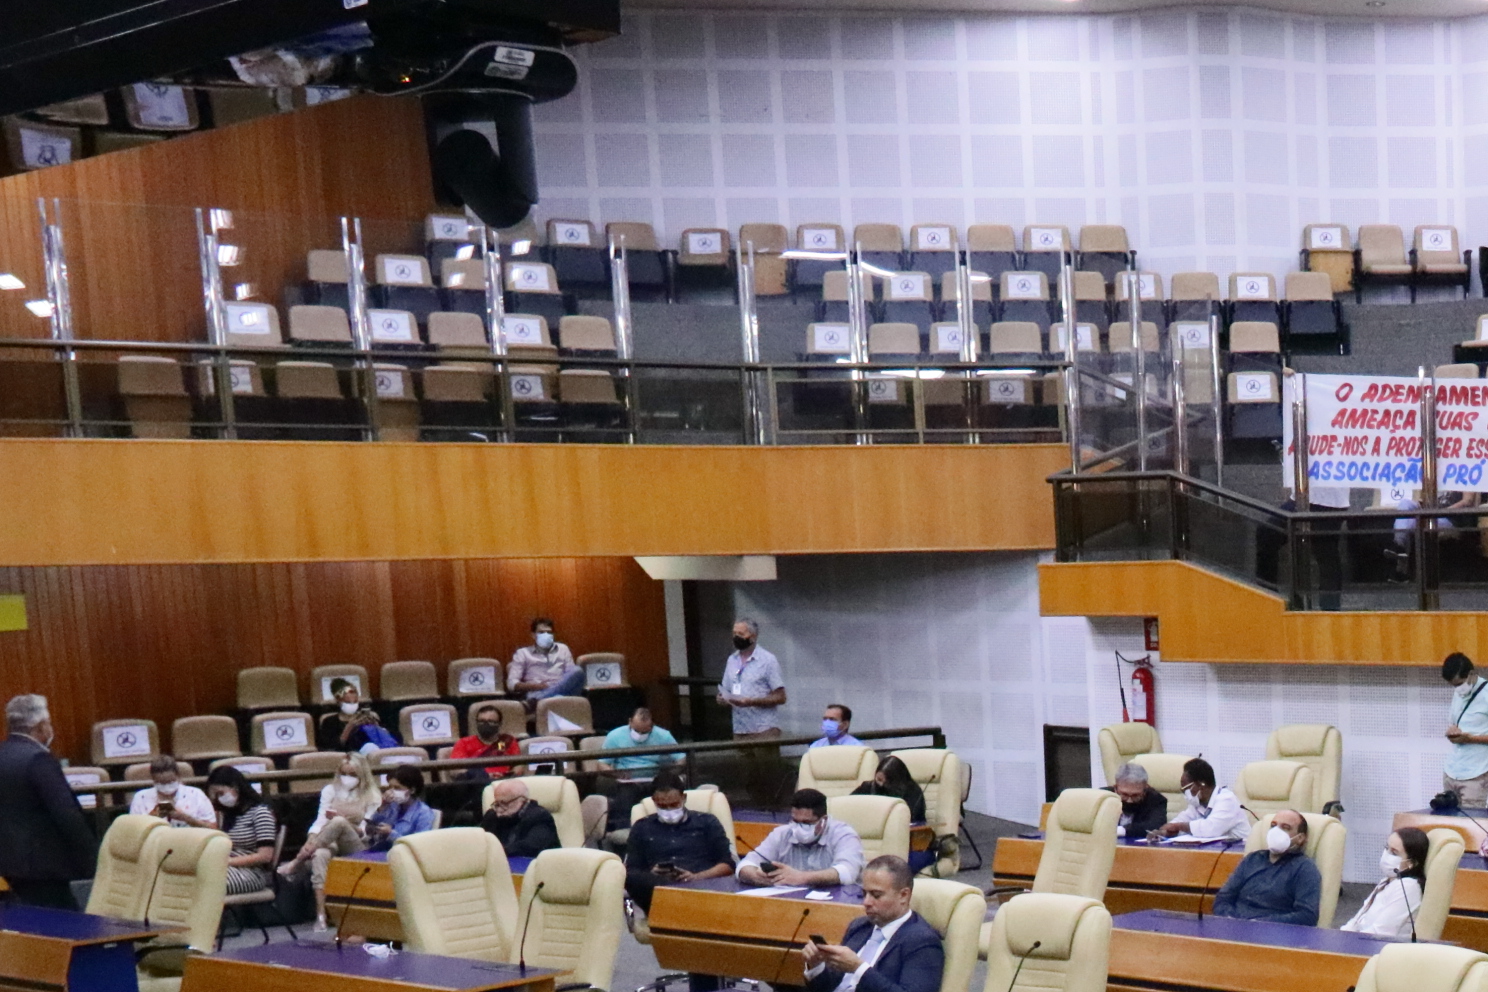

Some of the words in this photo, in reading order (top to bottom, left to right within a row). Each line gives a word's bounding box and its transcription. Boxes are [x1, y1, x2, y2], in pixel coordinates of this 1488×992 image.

[1335, 382, 1353, 403] O
[1331, 408, 1417, 434] AMEAÇA
[1436, 410, 1479, 431] UAS
[1288, 434, 1369, 456] UDE-NOS
[1371, 435, 1382, 457] A
[1386, 435, 1463, 459] PROTGER
[1308, 458, 1423, 486] ASSOCIAÇÃ
[1442, 458, 1486, 485] PRÓ
